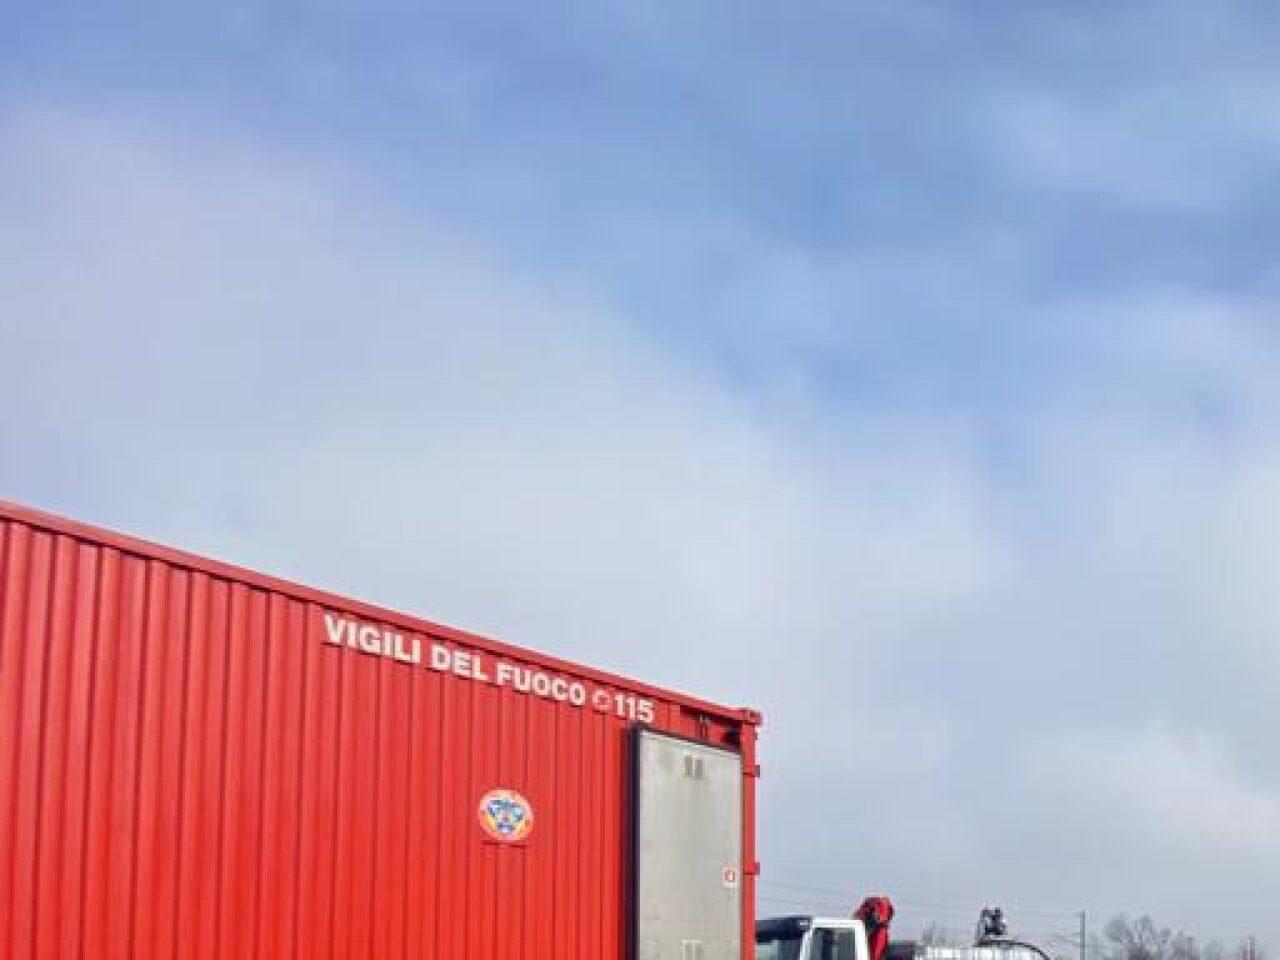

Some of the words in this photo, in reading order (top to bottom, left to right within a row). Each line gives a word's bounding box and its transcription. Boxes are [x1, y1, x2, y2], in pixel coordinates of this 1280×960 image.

[324, 614, 421, 664] VIGILI
[432, 644, 488, 681] DEL
[497, 661, 585, 706] FUOCO
[615, 693, 653, 723] 115
